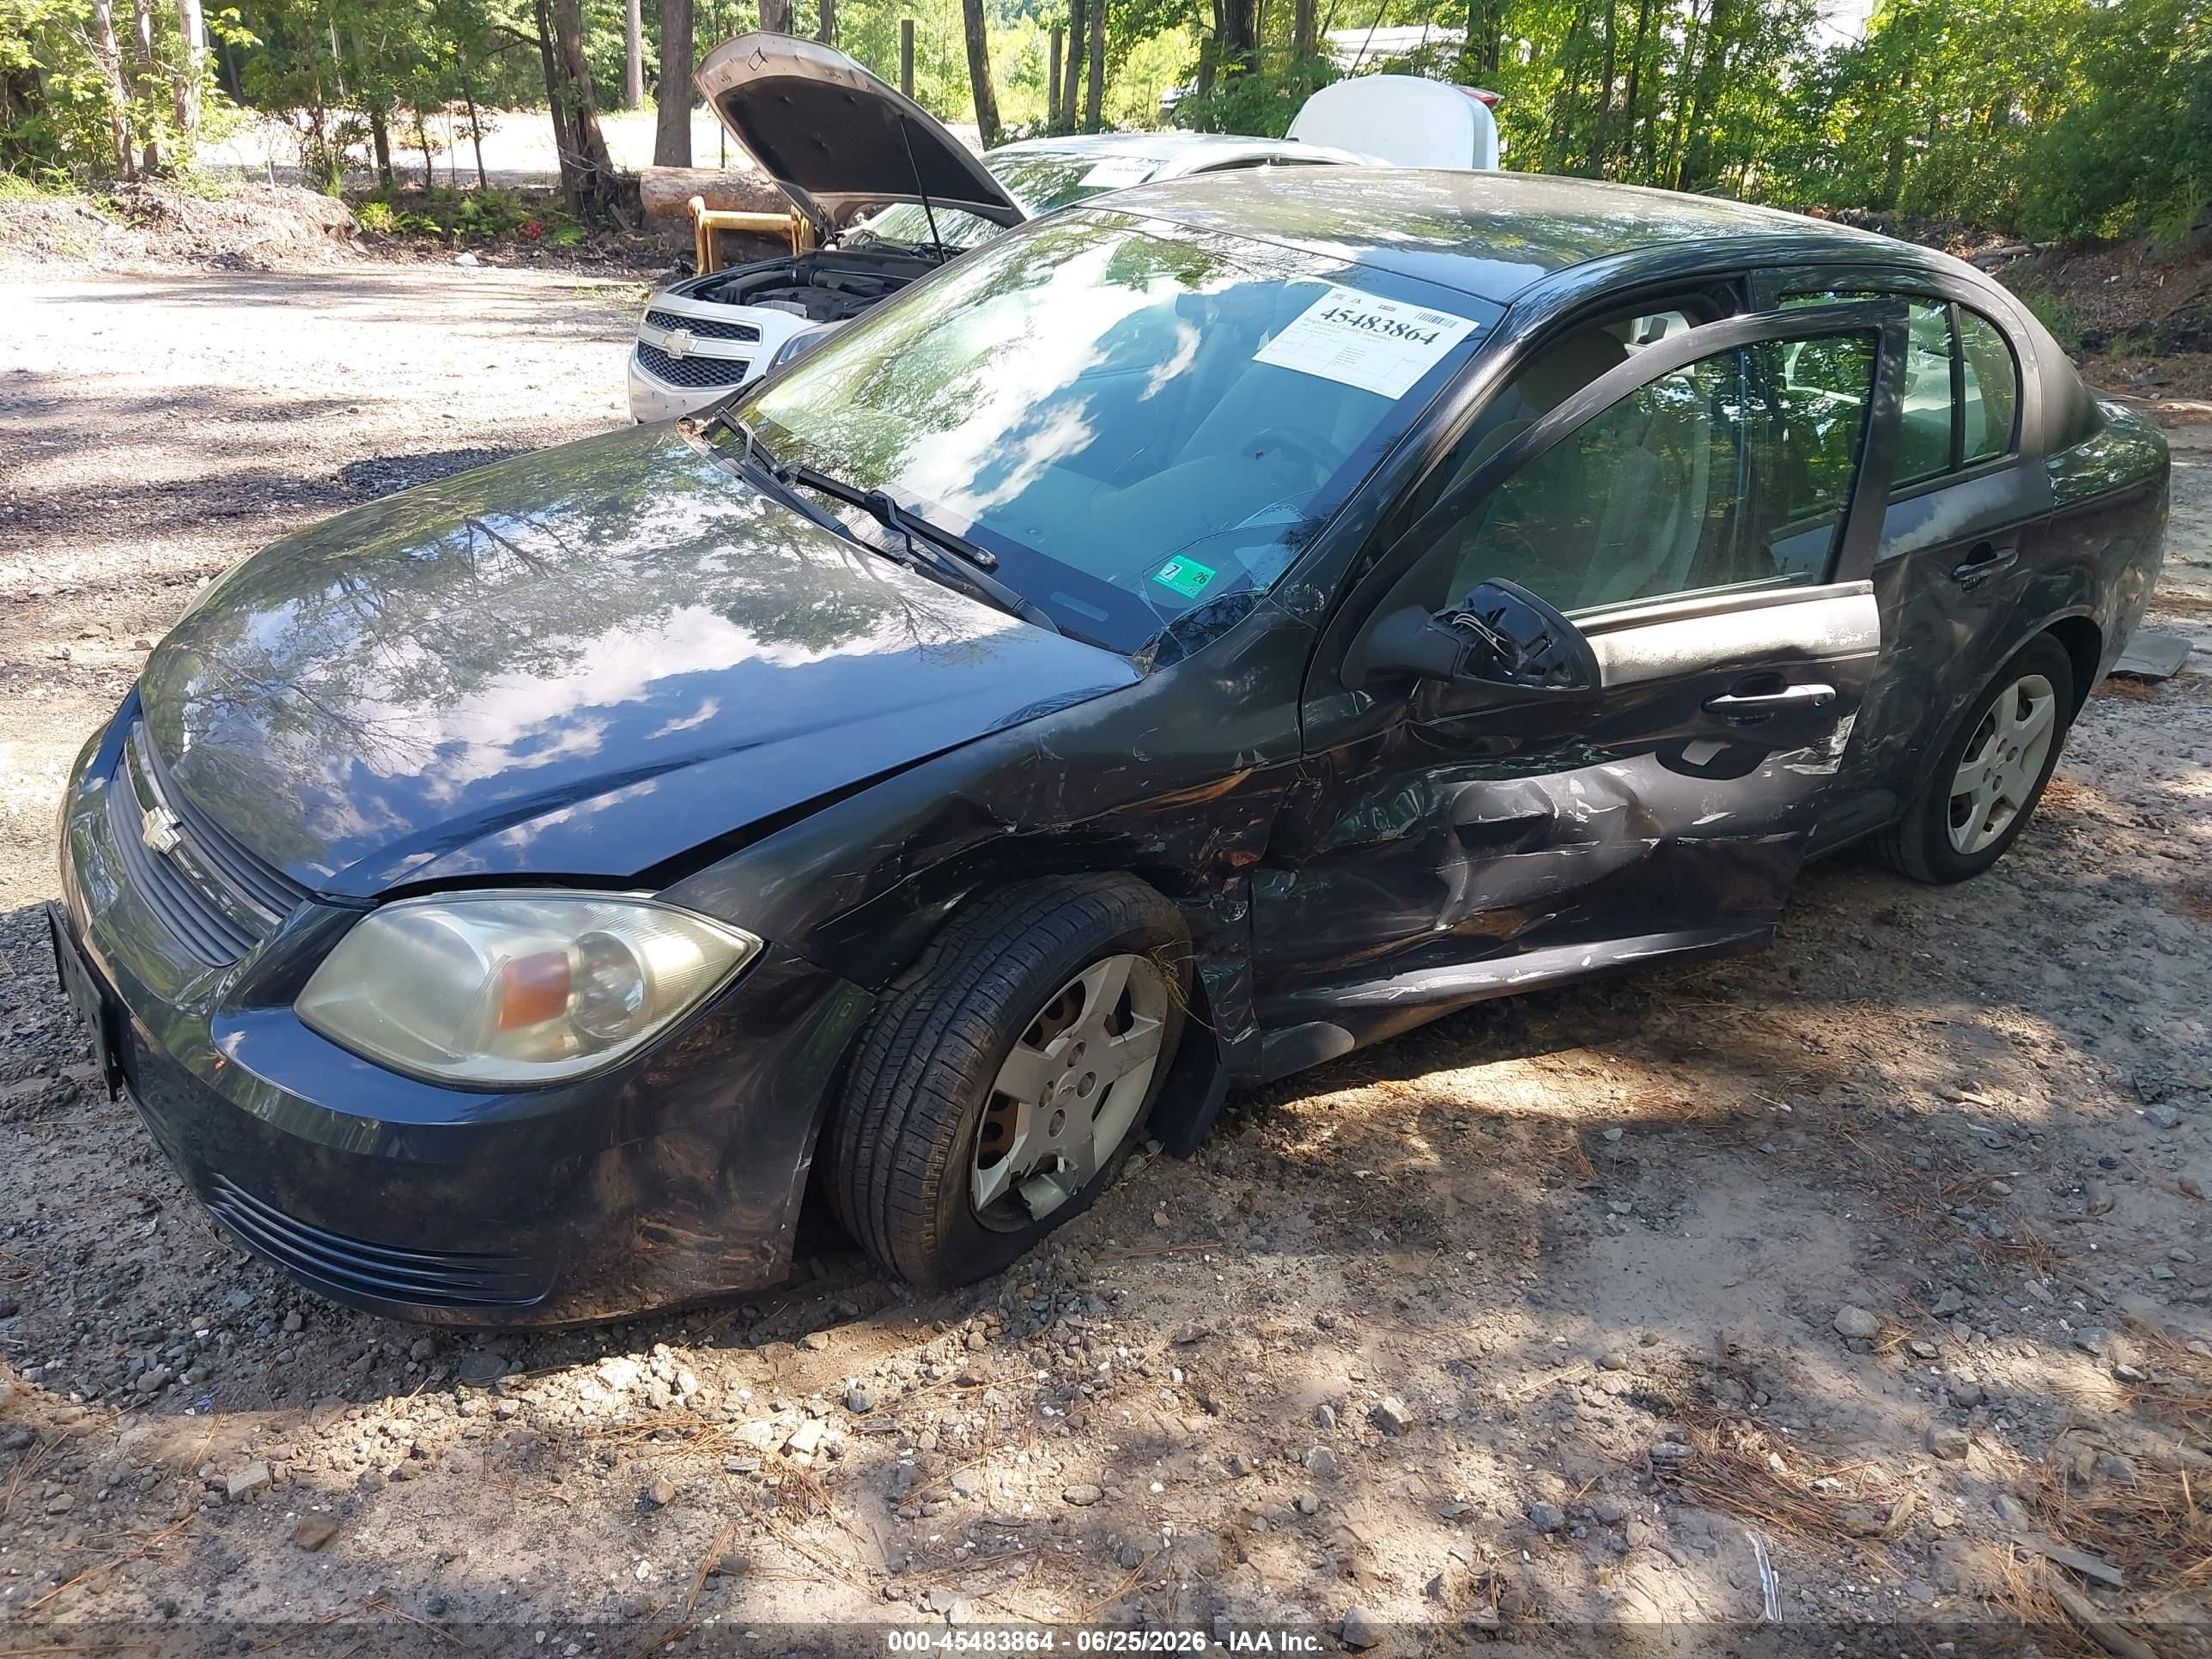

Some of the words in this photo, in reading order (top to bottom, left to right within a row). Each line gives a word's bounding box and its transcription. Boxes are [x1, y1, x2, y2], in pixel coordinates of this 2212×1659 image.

[1320, 307, 1441, 346] 45483864
[1165, 564, 1180, 576] 7
[1193, 571, 1210, 585] 26
